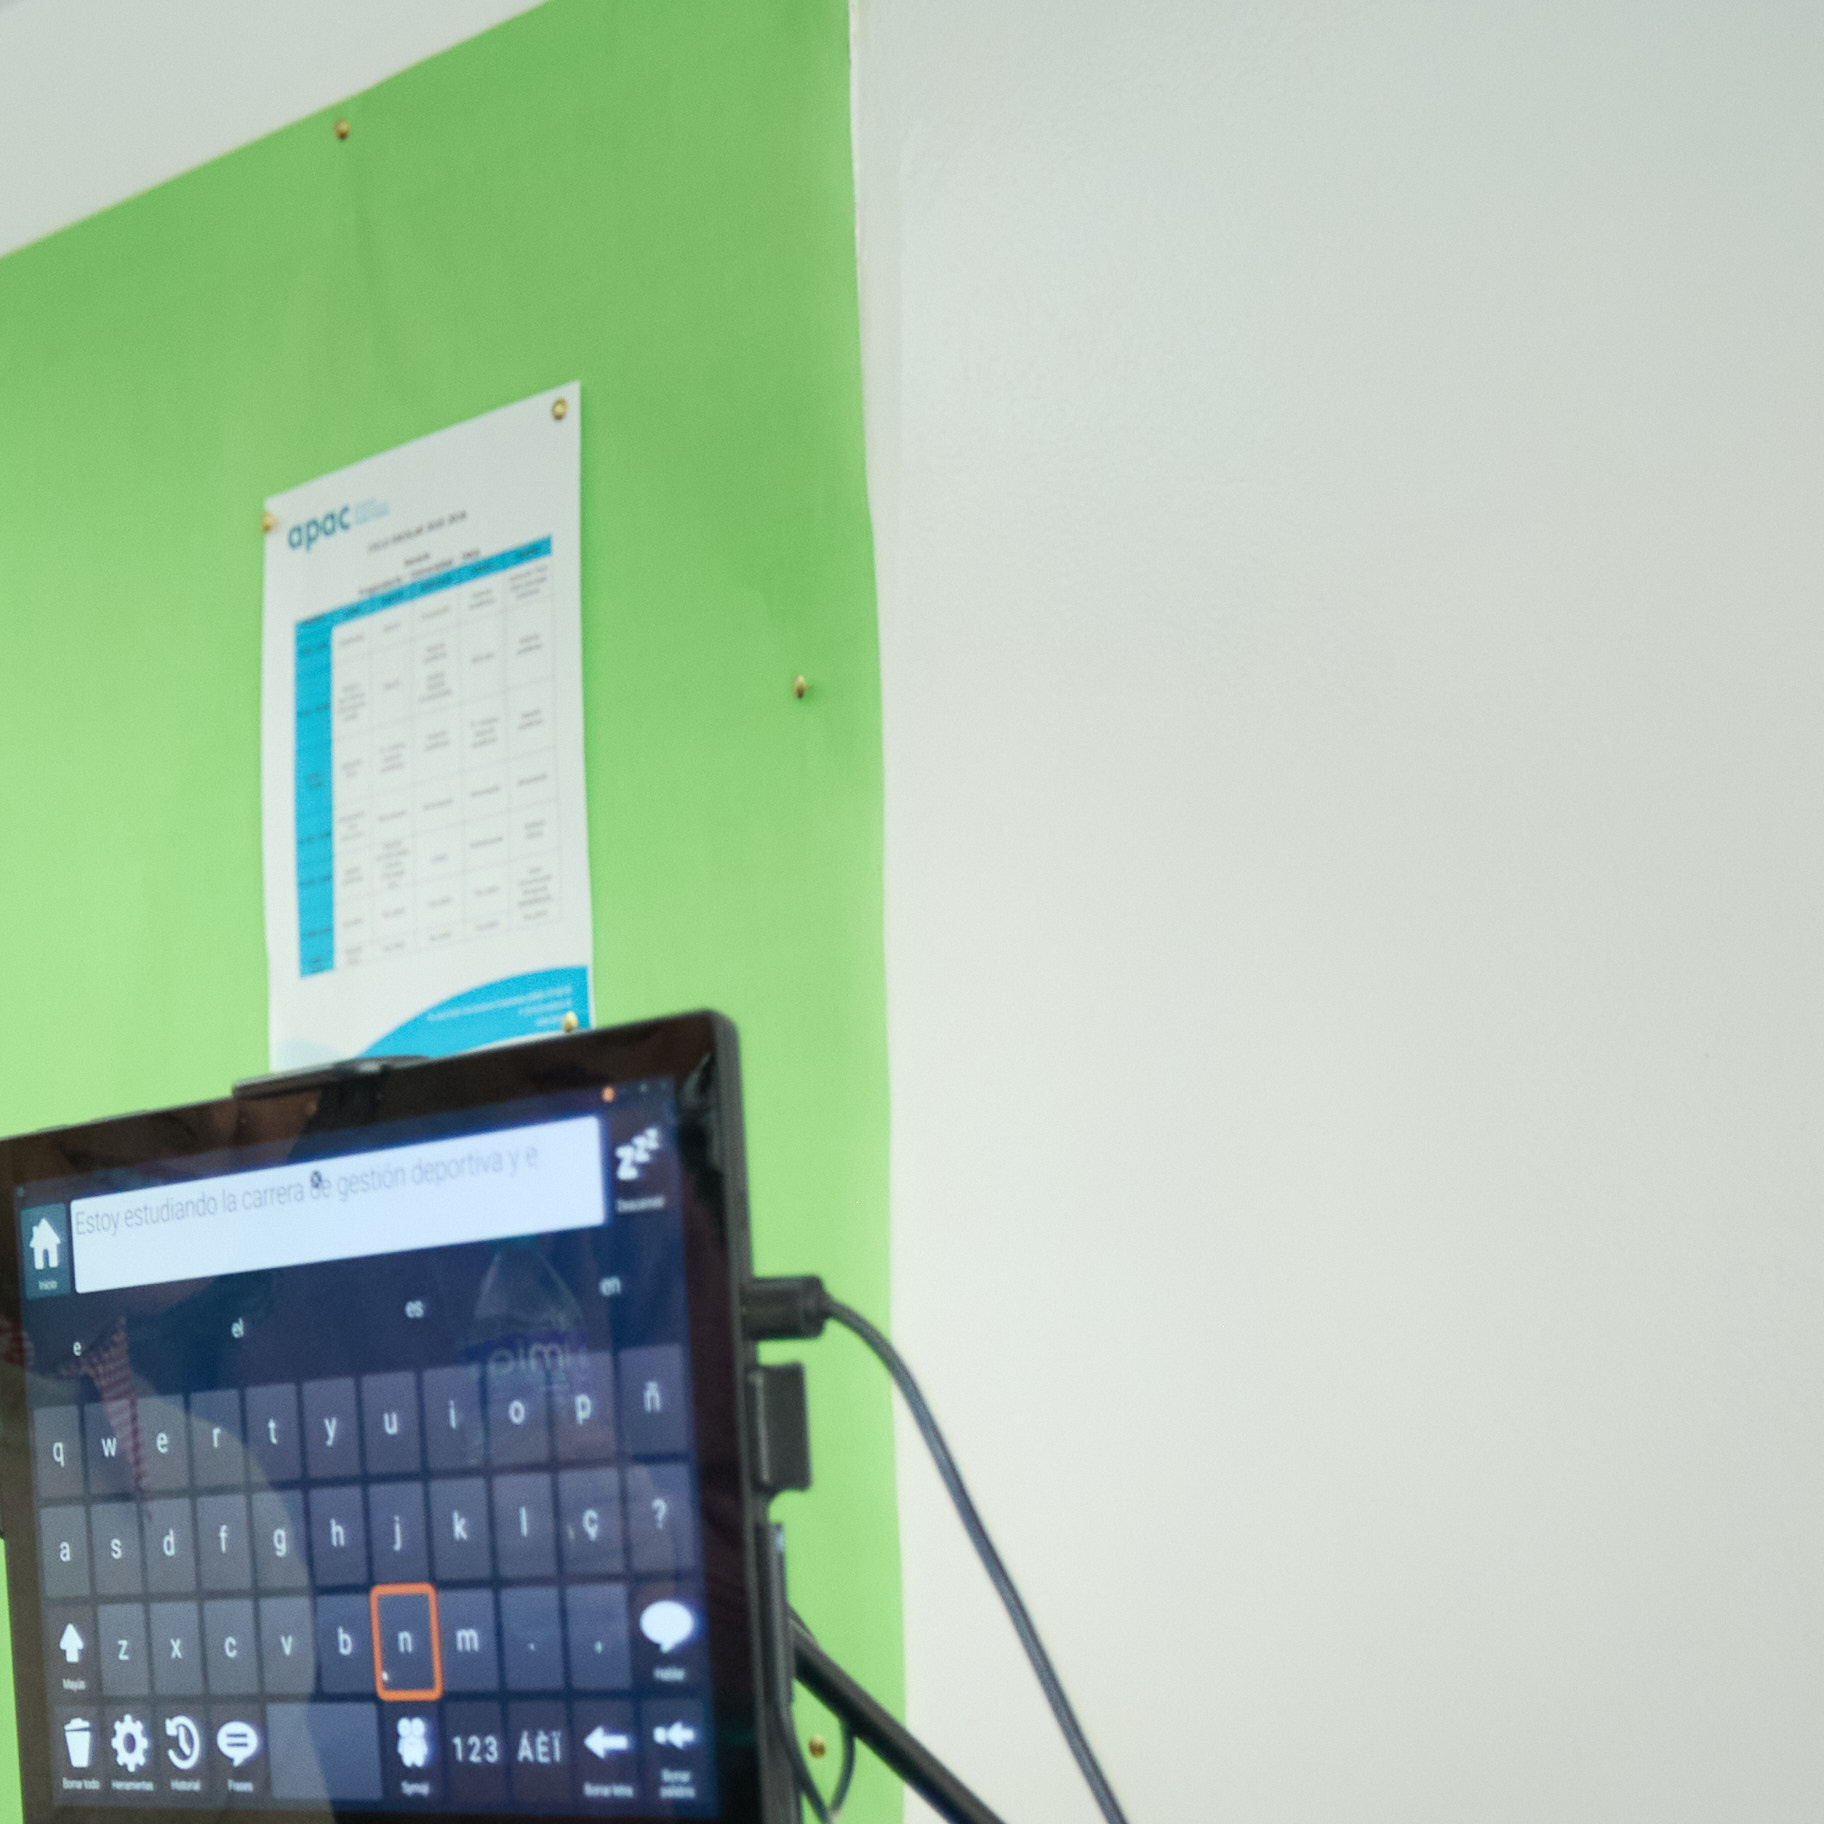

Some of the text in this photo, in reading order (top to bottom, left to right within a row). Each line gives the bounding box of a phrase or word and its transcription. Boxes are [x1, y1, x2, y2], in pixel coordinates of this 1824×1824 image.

[287, 505, 350, 553] apac
[75, 1210, 122, 1237] Estoy
[124, 1197, 219, 1228] estudiando
[222, 1190, 238, 1213] la
[242, 1182, 304, 1210] carrera
[337, 1164, 406, 1201] gestión
[411, 1151, 503, 1187] deportiva
[504, 1151, 519, 1177] y
[525, 1147, 539, 1167] e
[72, 1276, 622, 1356] e el es en
[52, 1380, 662, 1468] q w e r t y u i o p ñ
[59, 1498, 668, 1563] a s d f g h j k l ç ?
[117, 1638, 129, 1661] z
[169, 1637, 183, 1659] x
[224, 1635, 237, 1658] c
[280, 1634, 293, 1656] v
[337, 1625, 353, 1656] b
[397, 1630, 413, 1654] n
[455, 1627, 480, 1653] m
[452, 1734, 499, 1764] 123
